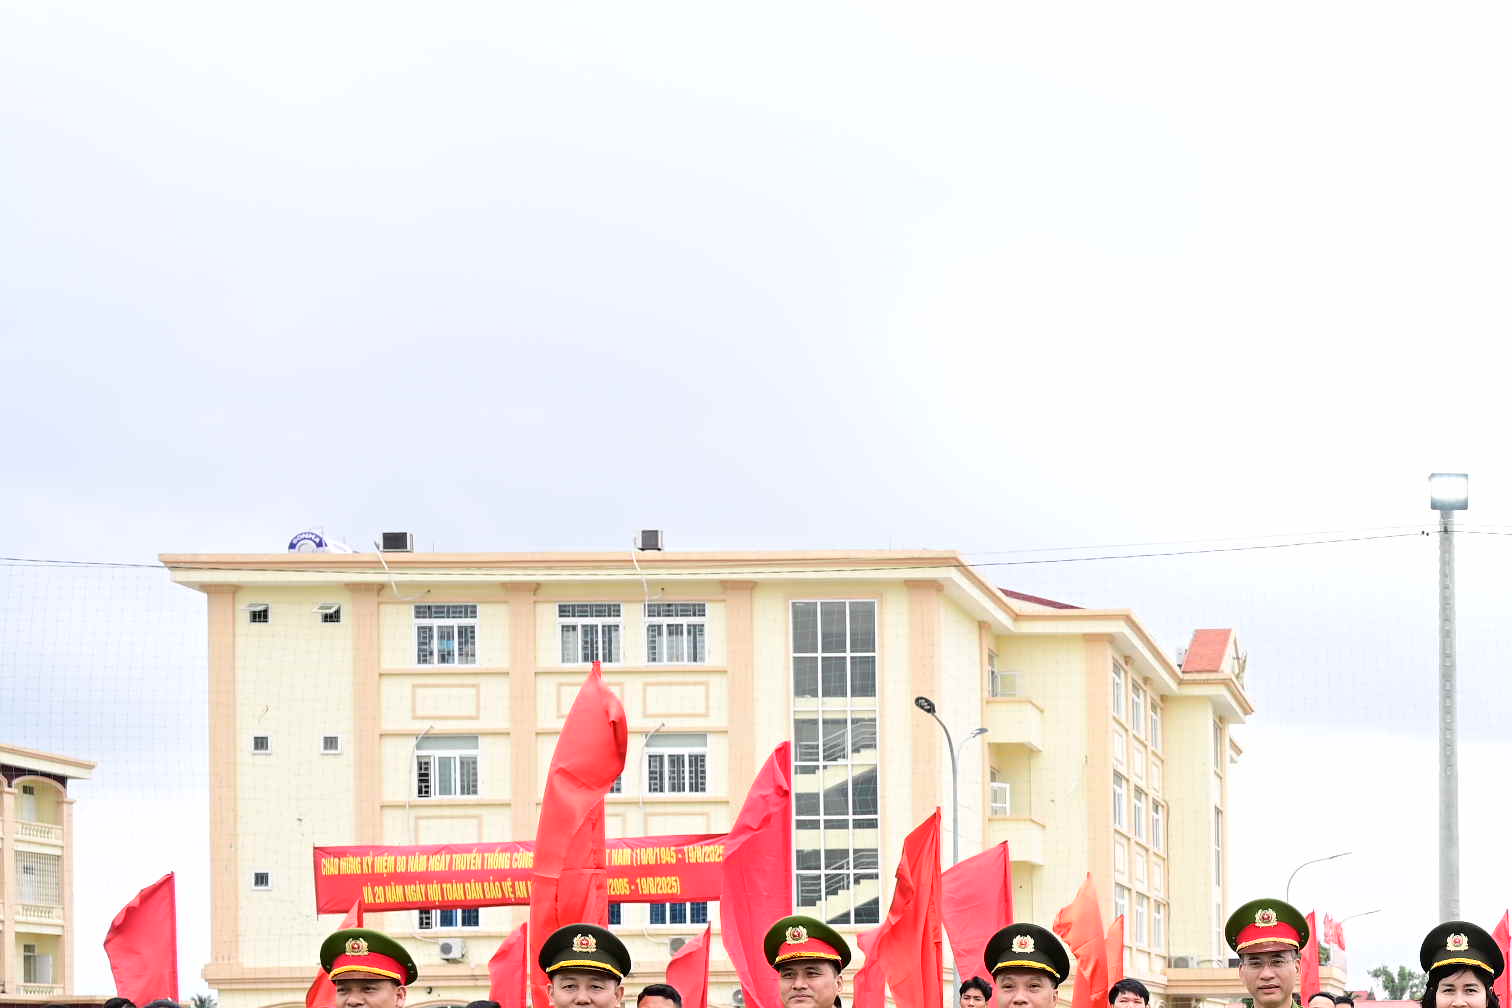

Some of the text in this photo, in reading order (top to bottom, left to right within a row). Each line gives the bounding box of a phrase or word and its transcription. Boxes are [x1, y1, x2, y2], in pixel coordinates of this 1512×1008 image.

[396, 856, 406, 873] 80
[408, 853, 427, 872] NĂM
[429, 854, 449, 872] NGÀY
[452, 848, 481, 870] TRUYỀN
[484, 849, 510, 869] THỐNG
[512, 849, 534, 868] CÔNG
[612, 848, 630, 865] NAM
[374, 886, 384, 903] 20
[385, 882, 404, 903] NĂM
[405, 881, 426, 902] NGÀY
[427, 882, 440, 904] HỘI
[441, 880, 464, 900] TOÀN
[466, 879, 483, 899] DÂN
[484, 876, 501, 899] BẢO
[515, 881, 526, 898] AN
